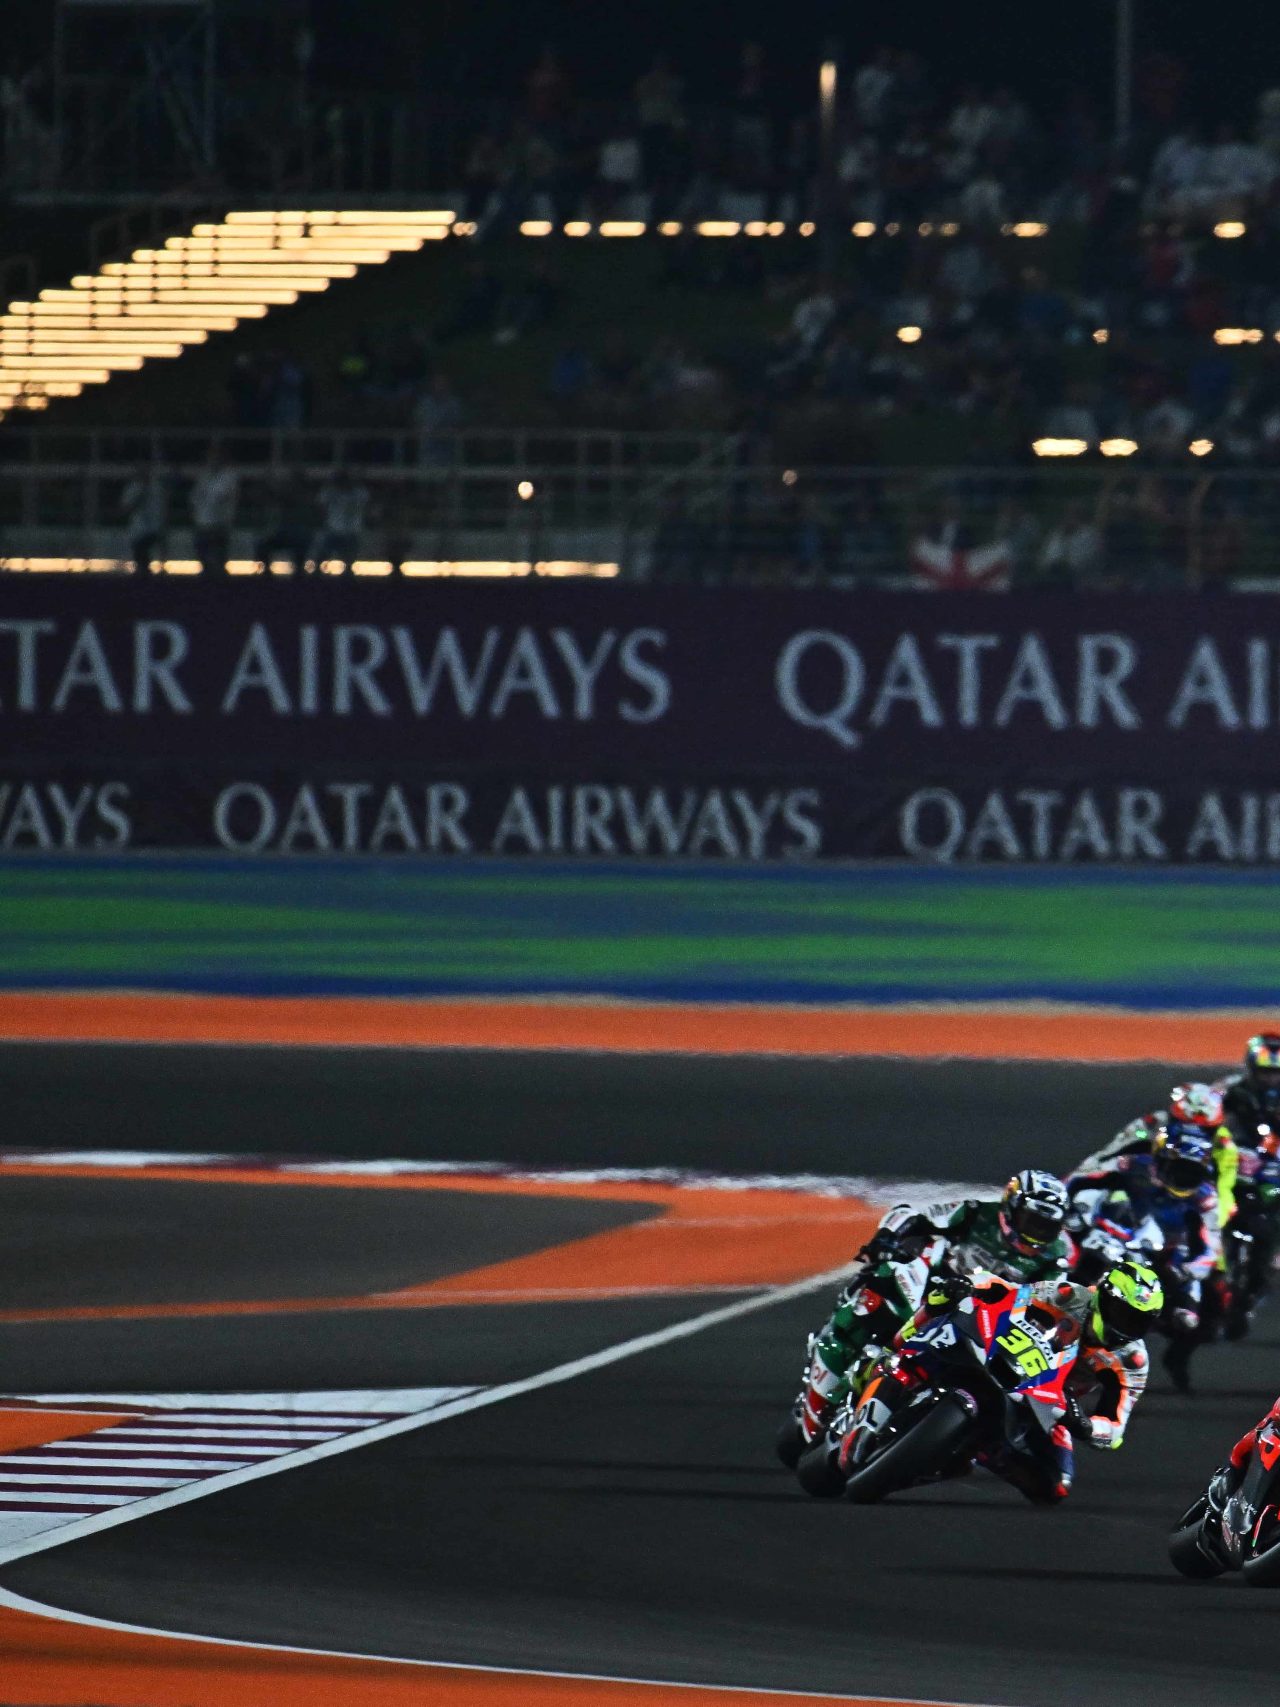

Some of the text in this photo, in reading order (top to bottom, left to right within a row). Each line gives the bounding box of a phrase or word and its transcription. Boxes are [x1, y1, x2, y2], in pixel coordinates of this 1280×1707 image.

[223, 622, 673, 724] AIRWAYS
[776, 630, 1140, 748] QATAR
[213, 782, 823, 858] QATAR AIRWAYS
[900, 786, 1167, 864] QATAR
[995, 1328, 1049, 1377] 36
